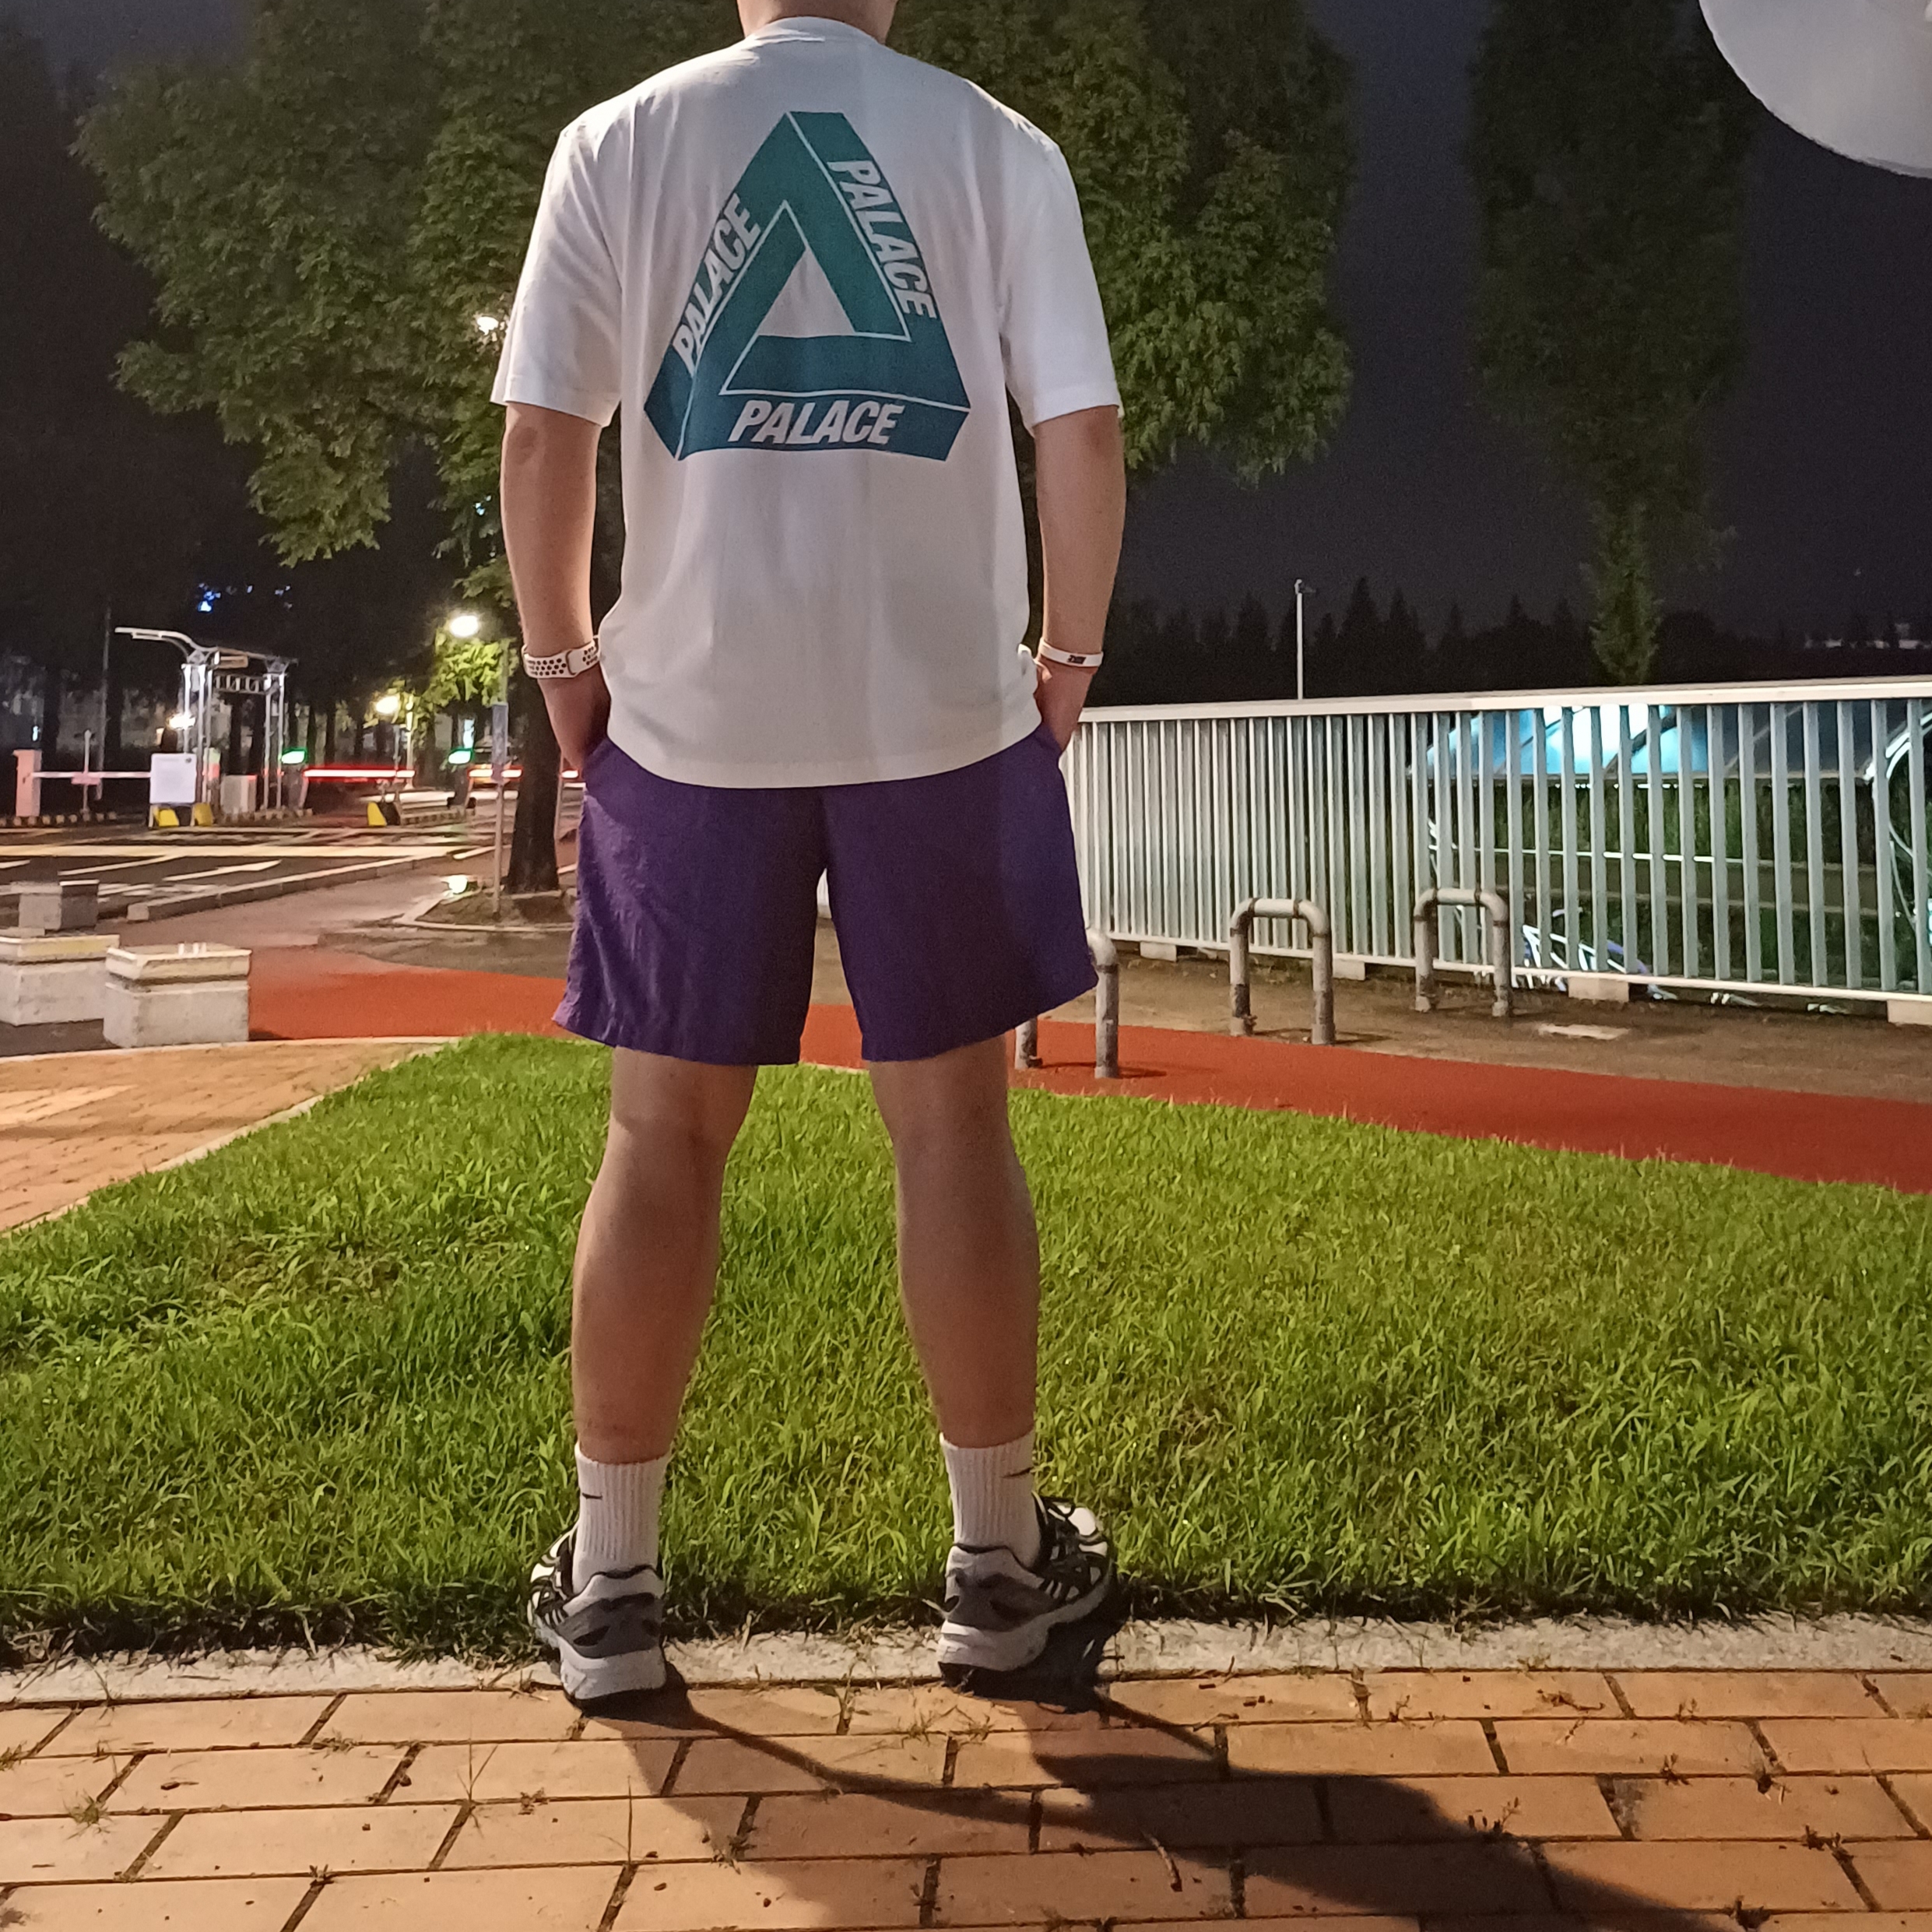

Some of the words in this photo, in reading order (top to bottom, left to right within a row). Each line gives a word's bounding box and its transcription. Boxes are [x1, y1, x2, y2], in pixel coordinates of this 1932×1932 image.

[672, 192, 761, 378] PALACE
[827, 160, 937, 319] PALACE
[727, 399, 905, 444] PALACE
